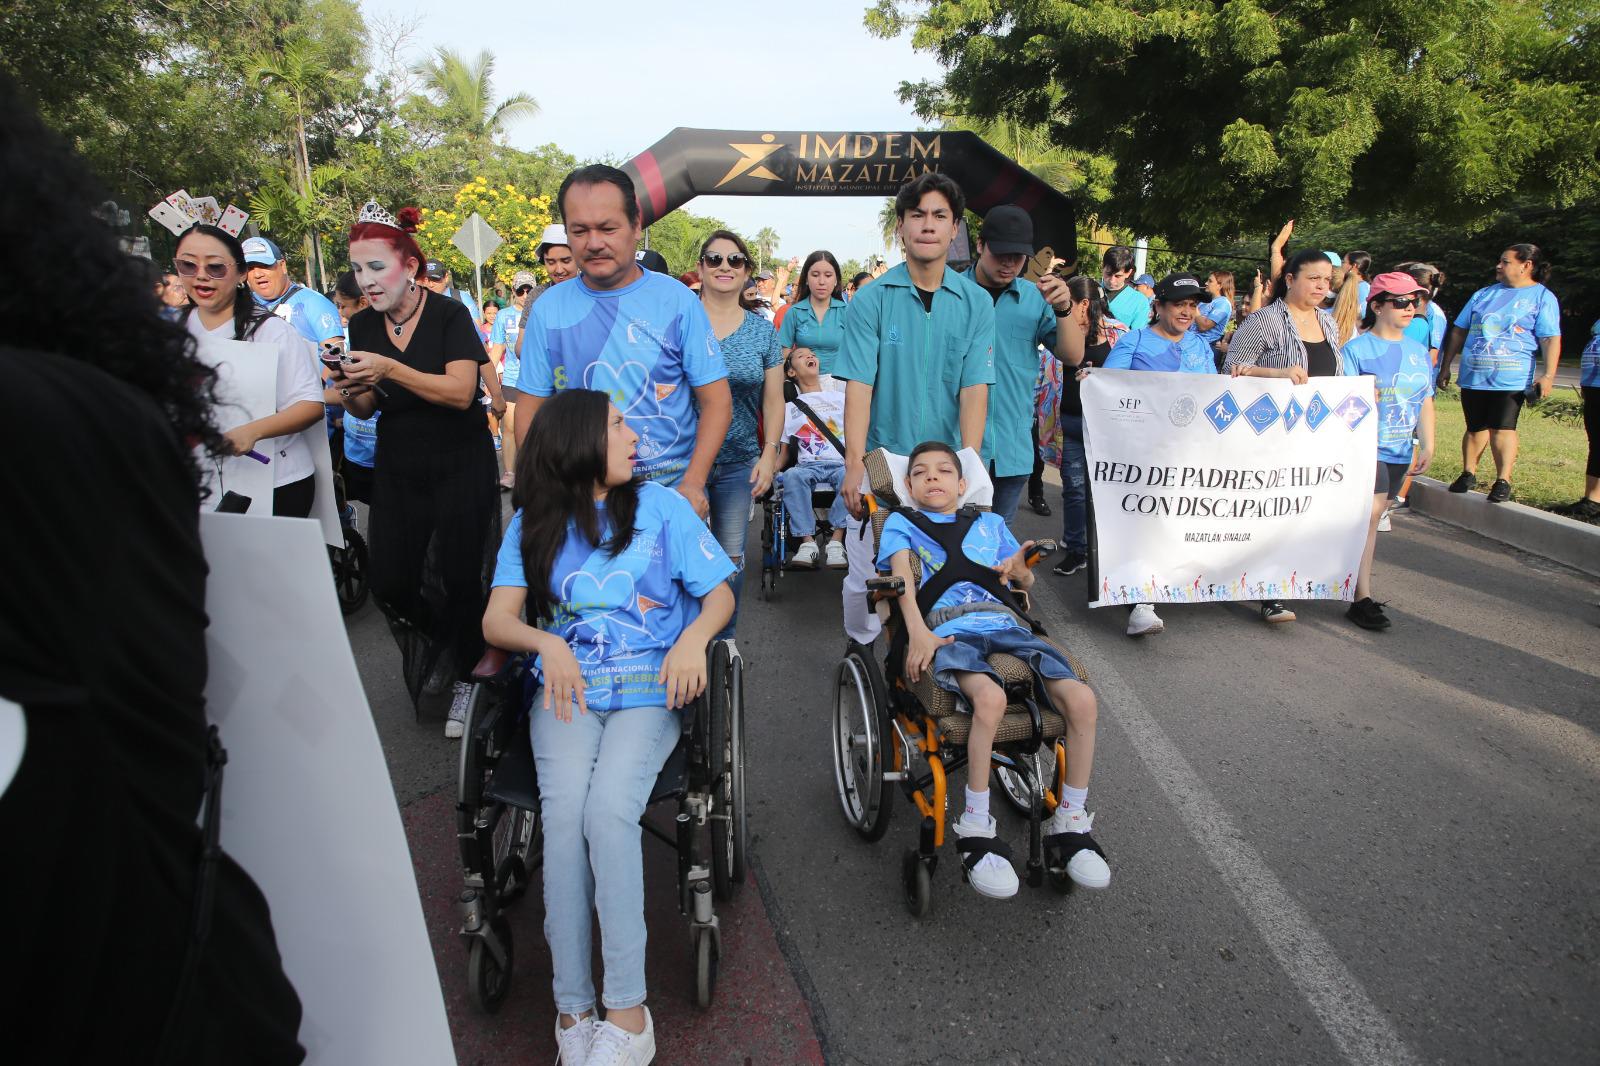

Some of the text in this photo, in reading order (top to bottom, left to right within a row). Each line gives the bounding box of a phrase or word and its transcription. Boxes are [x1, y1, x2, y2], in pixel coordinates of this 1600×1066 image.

[799, 134, 941, 158] IMDEM
[795, 184, 837, 192] INSTITUTO
[1118, 398, 1142, 410] SEP
[1094, 461, 1344, 490] RED DE PADRES DE HIJOS
[1121, 493, 1313, 518] CON DISCAPACIDAD
[588, 665, 652, 675] INTERNACIONAL
[614, 674, 659, 683] CEREBRA
